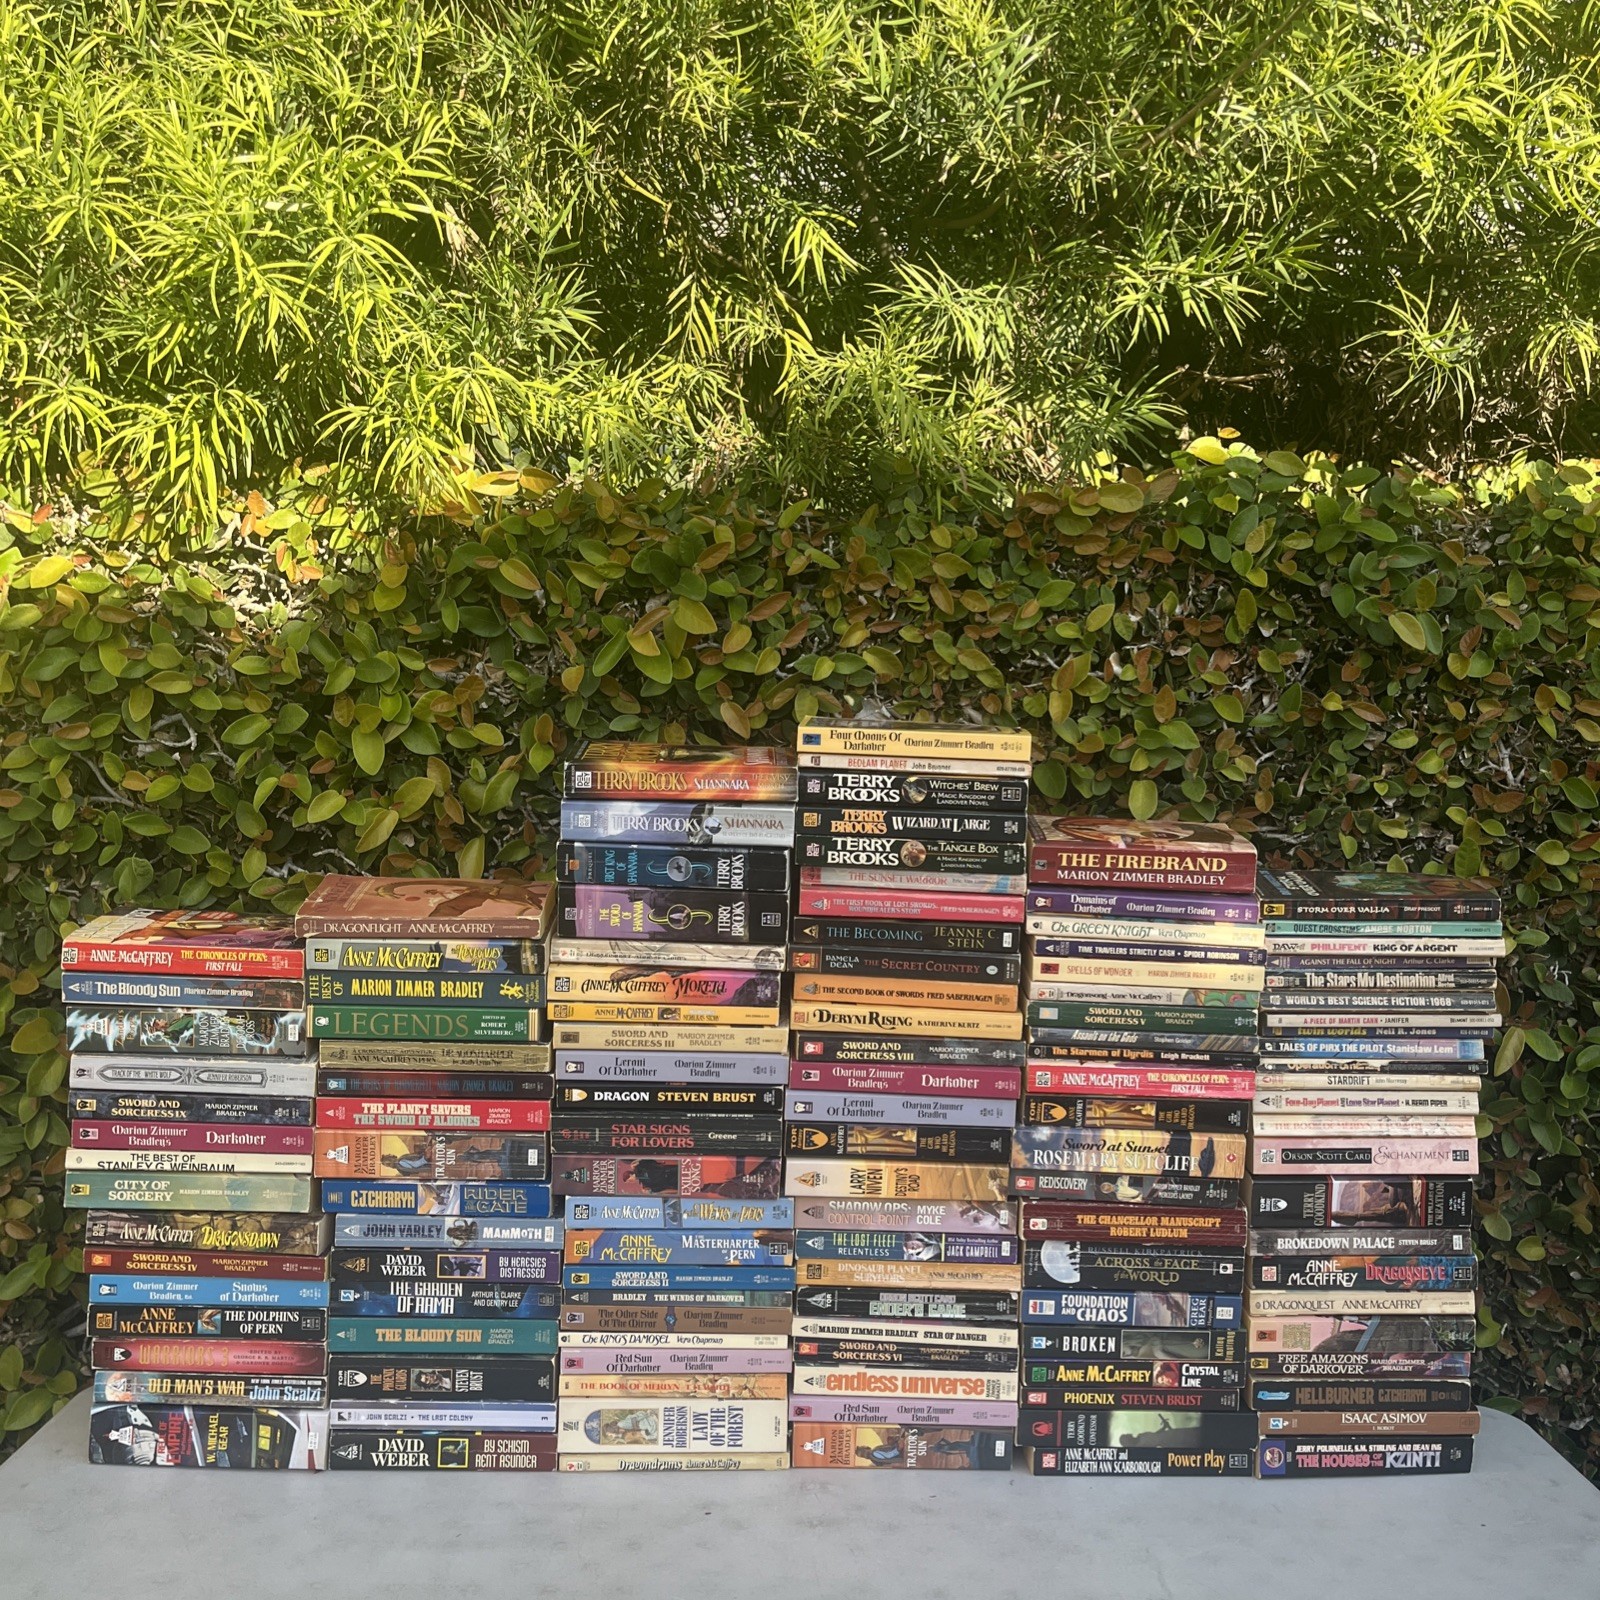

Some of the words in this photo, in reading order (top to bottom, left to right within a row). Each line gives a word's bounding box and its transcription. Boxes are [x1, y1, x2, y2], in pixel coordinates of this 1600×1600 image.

[848, 759, 878, 768] BEDLAM
[881, 760, 907, 769] PLANET
[596, 771, 637, 790] TERRY
[639, 772, 687, 790] BROOKS
[694, 779, 749, 789] SHANNARA
[833, 774, 896, 788] TERRY
[974, 782, 999, 791] BREW
[828, 788, 900, 803] BROOKS
[892, 816, 938, 830] WIZARD
[940, 819, 952, 828] AT
[953, 819, 990, 832] LARGE
[1058, 853, 1100, 867] THE
[1105, 855, 1227, 871] FIREBRAND
[1057, 870, 1109, 880] MARION
[1113, 872, 1164, 883] ZIMMER
[1168, 874, 1225, 885] BRADLEY
[324, 924, 402, 932] DRAGONFLIGHT
[408, 924, 437, 933] ANNE
[438, 924, 495, 933] McCAFFREY
[827, 927, 850, 937] THE
[854, 927, 923, 940] BECOMING
[934, 926, 983, 938] JEANNE
[988, 928, 999, 938] C.
[948, 939, 985, 948] STEIN
[1095, 946, 1127, 954] TRAVELERS
[1129, 948, 1156, 956] STRICTLY
[1207, 952, 1239, 960] ROBINSON
[90, 950, 117, 962] ANNE
[119, 951, 173, 967] McCAFFREY
[205, 962, 225, 971] FIRST
[227, 962, 242, 972] FALL
[95, 982, 117, 994] The
[118, 983, 157, 997] Bloody
[159, 984, 180, 996] Sun
[310, 975, 319, 998] THE
[322, 974, 331, 999] BEST
[334, 981, 343, 995] OF
[351, 979, 391, 996] MARION
[396, 980, 434, 997] ZIMMER
[441, 981, 484, 998] BRADLEY
[1089, 1007, 1121, 1015] SWORD
[1123, 1008, 1142, 1016] AND
[334, 1011, 469, 1037] LEGENDS
[1084, 1016, 1139, 1024] SORCERESS
[612, 1030, 645, 1038] SWORD
[605, 1039, 662, 1047] SORCERESS
[1327, 1076, 1370, 1085] STARDRIFT
[594, 1092, 649, 1101] DRAGON
[657, 1092, 708, 1102] STEVEN
[713, 1093, 756, 1102] BRUST
[118, 1099, 156, 1108] SWORD
[158, 1099, 180, 1108] AND
[362, 1103, 384, 1113] THE
[387, 1104, 427, 1114] PLANET
[430, 1105, 471, 1115] SAVERS
[111, 1108, 173, 1117] SORCERESS
[174, 1109, 187, 1118] IX
[612, 1124, 646, 1134] STAR
[650, 1125, 690, 1134] SIGNS
[709, 1132, 737, 1140] Greene
[612, 1137, 639, 1147] FOR
[643, 1137, 694, 1147] LOVERS
[1282, 1151, 1314, 1161] ORSON
[1316, 1151, 1342, 1161] SCOTT
[1345, 1151, 1370, 1161] CARD
[114, 1181, 150, 1189] CITY
[154, 1181, 170, 1190] OF
[1039, 1177, 1087, 1190] REDISCOVERY
[108, 1191, 173, 1200] SORCERY
[917, 1206, 946, 1215] MYKE
[917, 1216, 941, 1224] COLE
[1077, 1215, 1096, 1224] THE
[1098, 1216, 1158, 1226] CHANCELLOR
[1161, 1217, 1221, 1227] MANUSCRIPT
[1110, 1227, 1146, 1237] ROBERT
[1150, 1229, 1188, 1237] LUDLUM
[1277, 1238, 1349, 1249] BROKEDOWN
[1353, 1238, 1394, 1248] PALACE
[839, 1248, 889, 1256] RELENTLESS
[386, 1255, 422, 1265] DAVID
[499, 1257, 509, 1267] BY
[511, 1257, 547, 1268] HERESIES
[380, 1265, 427, 1276] WEBER
[1305, 1260, 1342, 1272] ANNE
[500, 1268, 545, 1278] DISTRESSED
[1287, 1273, 1358, 1287] McCAFFREY
[1062, 1295, 1128, 1307] FOUNDATION
[225, 1311, 247, 1320] THE
[250, 1312, 299, 1322] DOLPHINS
[1077, 1309, 1128, 1321] CHAOS
[240, 1324, 254, 1333] OF
[256, 1324, 283, 1333] PERN
[376, 1329, 402, 1341] THE
[405, 1329, 453, 1342] BLOODY
[456, 1330, 482, 1342] SUN
[956, 1333, 986, 1341] DANGER
[1063, 1337, 1115, 1353] BROKEN
[1279, 1355, 1308, 1363] FREE
[1311, 1355, 1368, 1364] AMAZONS
[1182, 1364, 1219, 1375] CRYSTAL
[1283, 1365, 1300, 1374] OF
[1302, 1365, 1364, 1375] DARKOVER
[148, 1379, 171, 1393] OLD
[175, 1380, 213, 1395] MAN'S
[218, 1381, 245, 1395] WAR
[827, 1372, 898, 1390] endless
[902, 1375, 985, 1395] universe
[1182, 1377, 1201, 1387] LINE
[1064, 1393, 1114, 1404] PHOENIX
[1121, 1395, 1164, 1405] STEVEN
[1167, 1395, 1202, 1405] BRUST
[1342, 1414, 1377, 1423] ISAAC
[1381, 1414, 1427, 1423] ASIMOV
[208, 1413, 218, 1450] MICHAEL
[663, 1407, 674, 1448] JENNIFER
[675, 1406, 687, 1448] ROBERSON
[219, 1426, 228, 1450] GEAR
[378, 1439, 424, 1452] DAVID
[371, 1453, 429, 1467] WEBER
[1168, 1453, 1201, 1468] Power
[1204, 1450, 1225, 1473] Play
[1386, 1452, 1441, 1468] KZINTI
